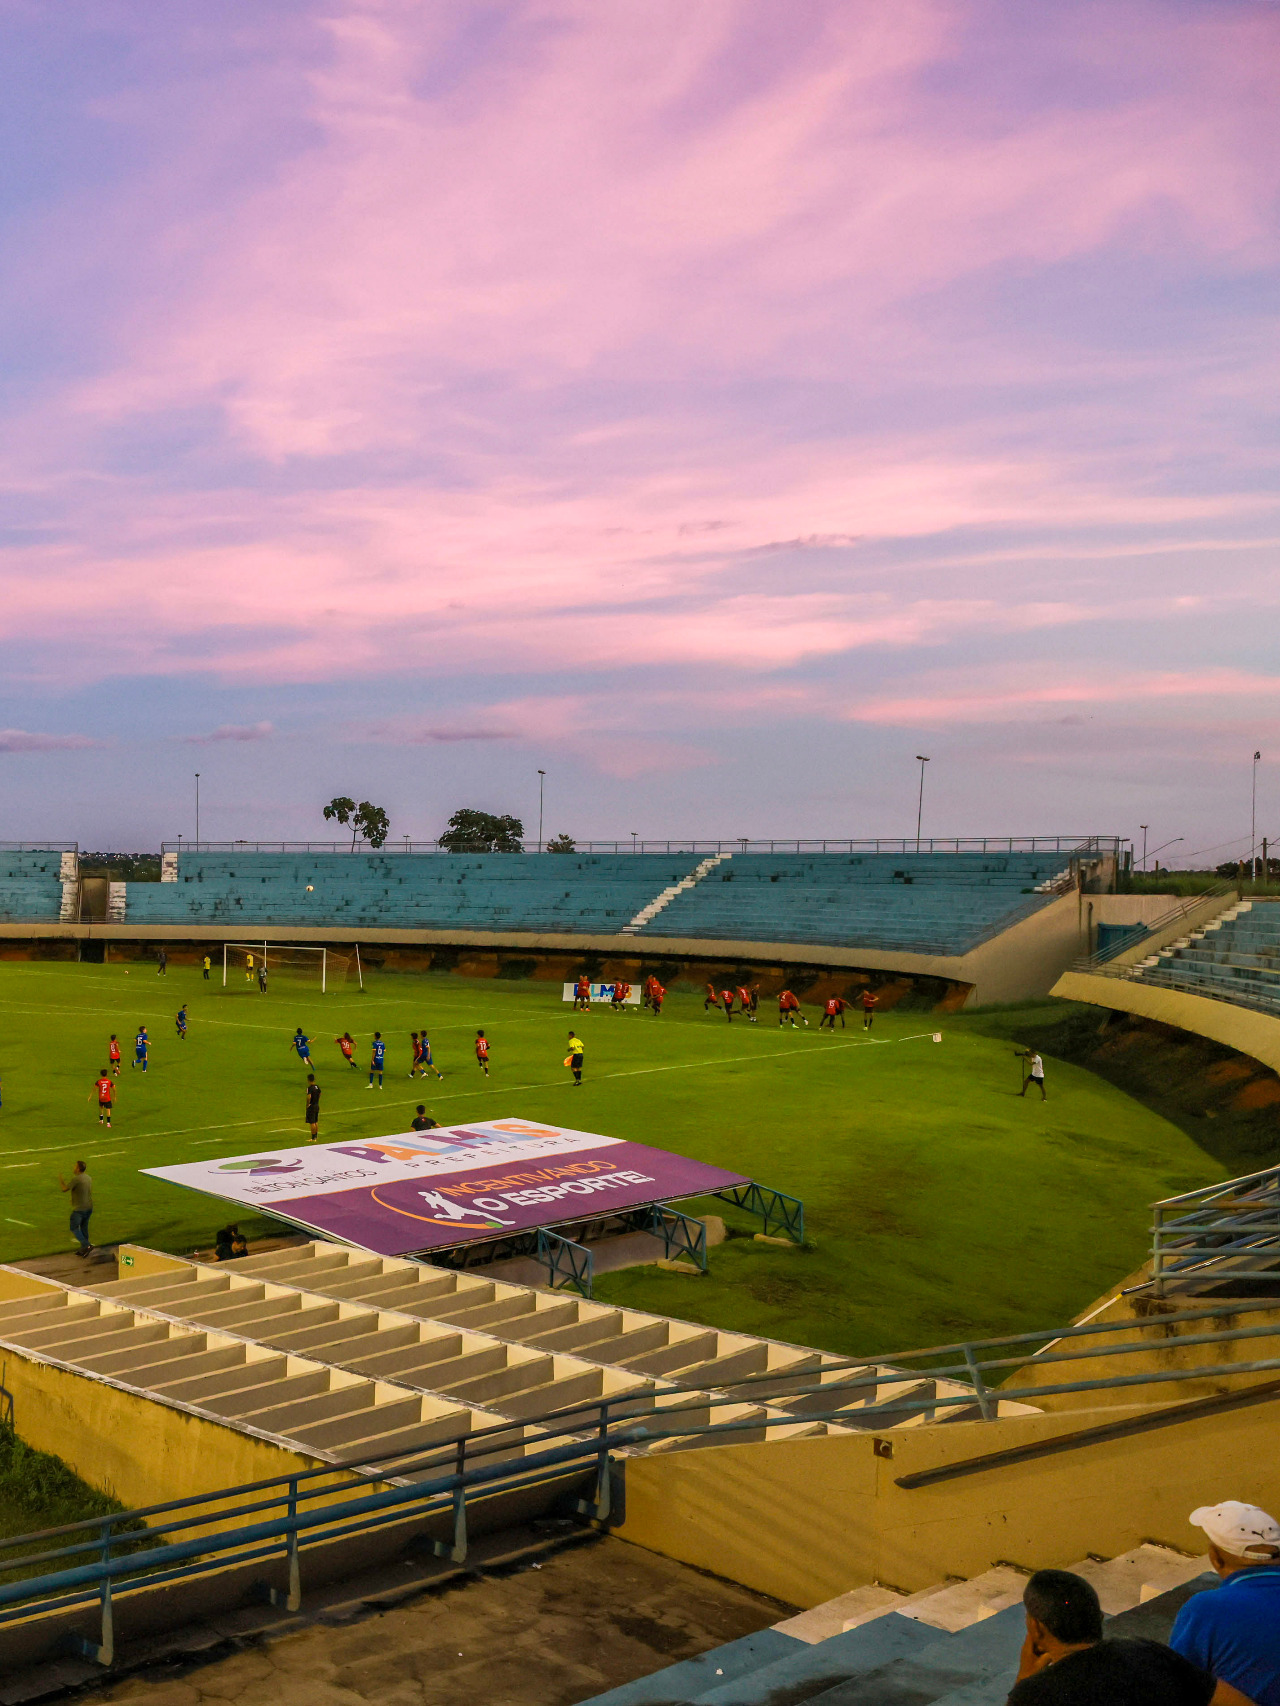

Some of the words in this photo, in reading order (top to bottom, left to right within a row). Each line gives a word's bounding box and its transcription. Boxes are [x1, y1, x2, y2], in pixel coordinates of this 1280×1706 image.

[326, 1123, 562, 1164] PALMAS
[435, 1160, 617, 1197] INCENTIVANDO
[472, 1197, 510, 1211] O
[498, 1170, 656, 1207] ESPORTE!
